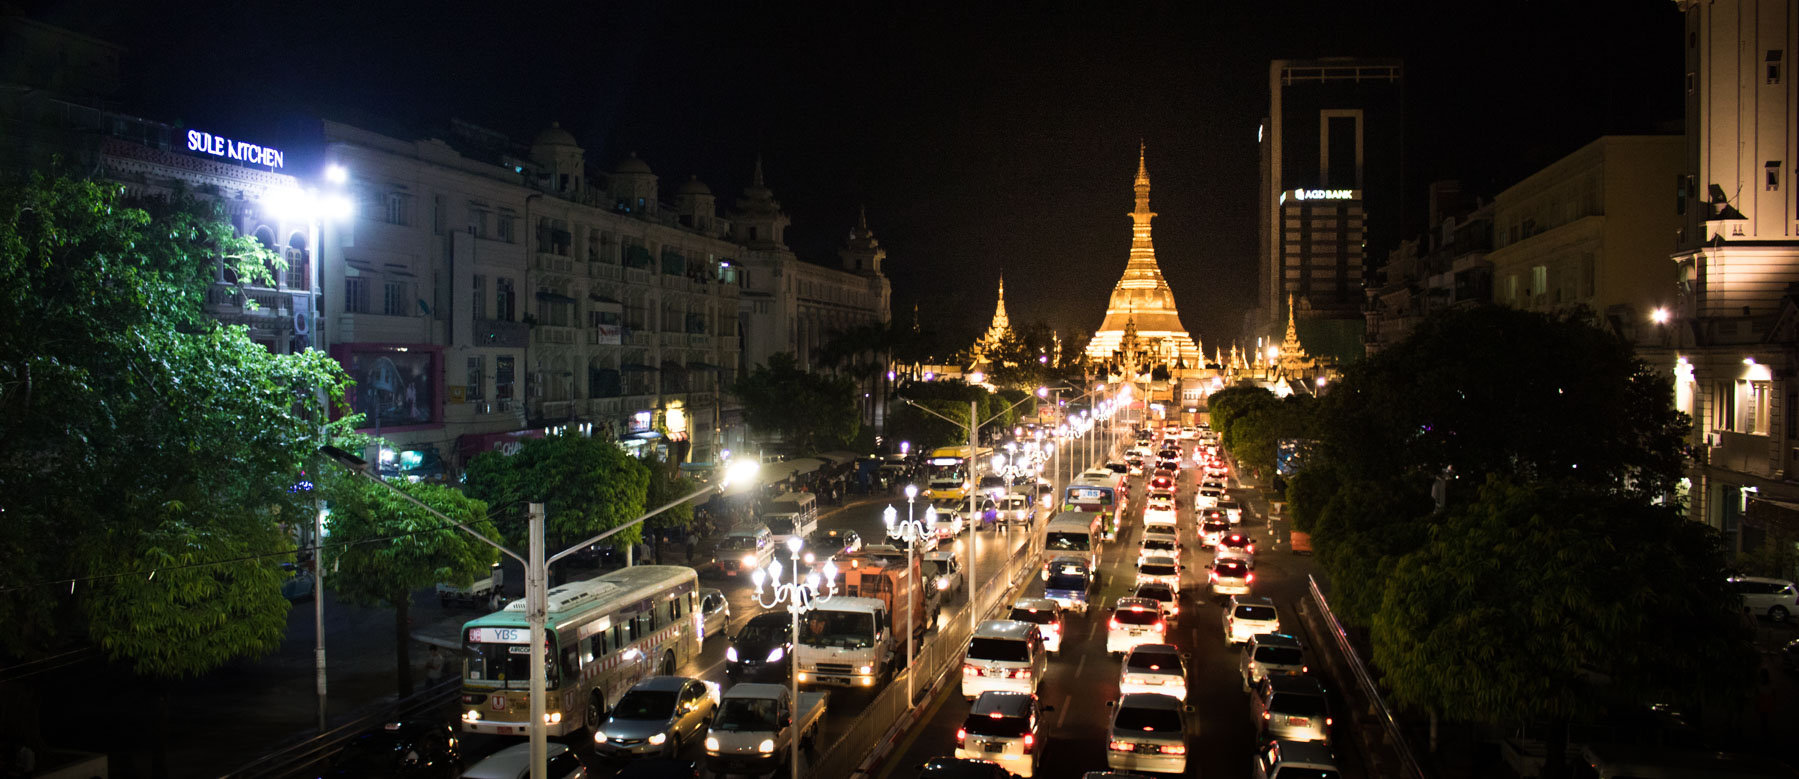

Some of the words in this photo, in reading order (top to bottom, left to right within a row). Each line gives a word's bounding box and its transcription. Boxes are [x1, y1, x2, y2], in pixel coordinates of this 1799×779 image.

[188, 130, 224, 156] SULE
[227, 139, 283, 168] KITCHEN
[1304, 190, 1325, 199] AGD
[1326, 190, 1352, 199] BANK
[494, 629, 518, 641] YBS
[492, 696, 504, 710] U
